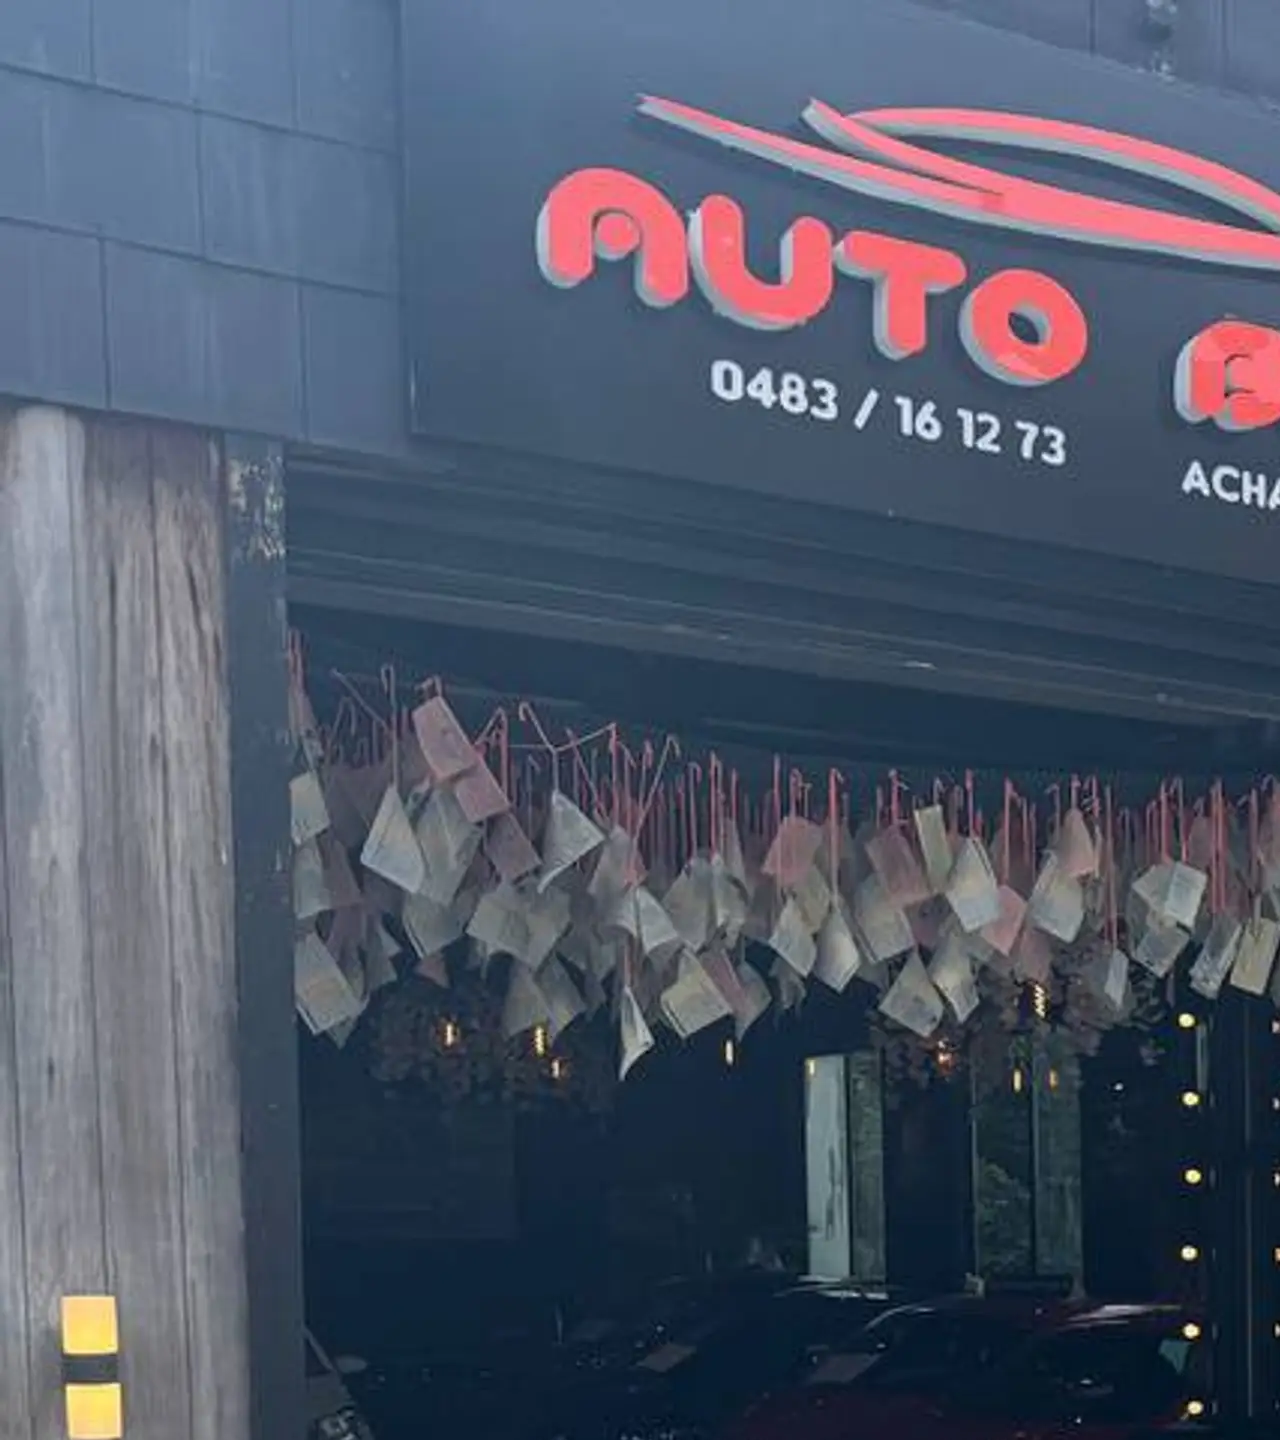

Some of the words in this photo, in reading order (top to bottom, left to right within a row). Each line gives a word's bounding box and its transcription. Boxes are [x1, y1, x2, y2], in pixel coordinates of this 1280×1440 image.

[537, 167, 1088, 385] AUTO
[710, 359, 838, 420] 0483
[854, 389, 879, 429] /
[894, 396, 941, 441] 16
[957, 408, 1001, 454] 12
[1015, 421, 1066, 466] 73
